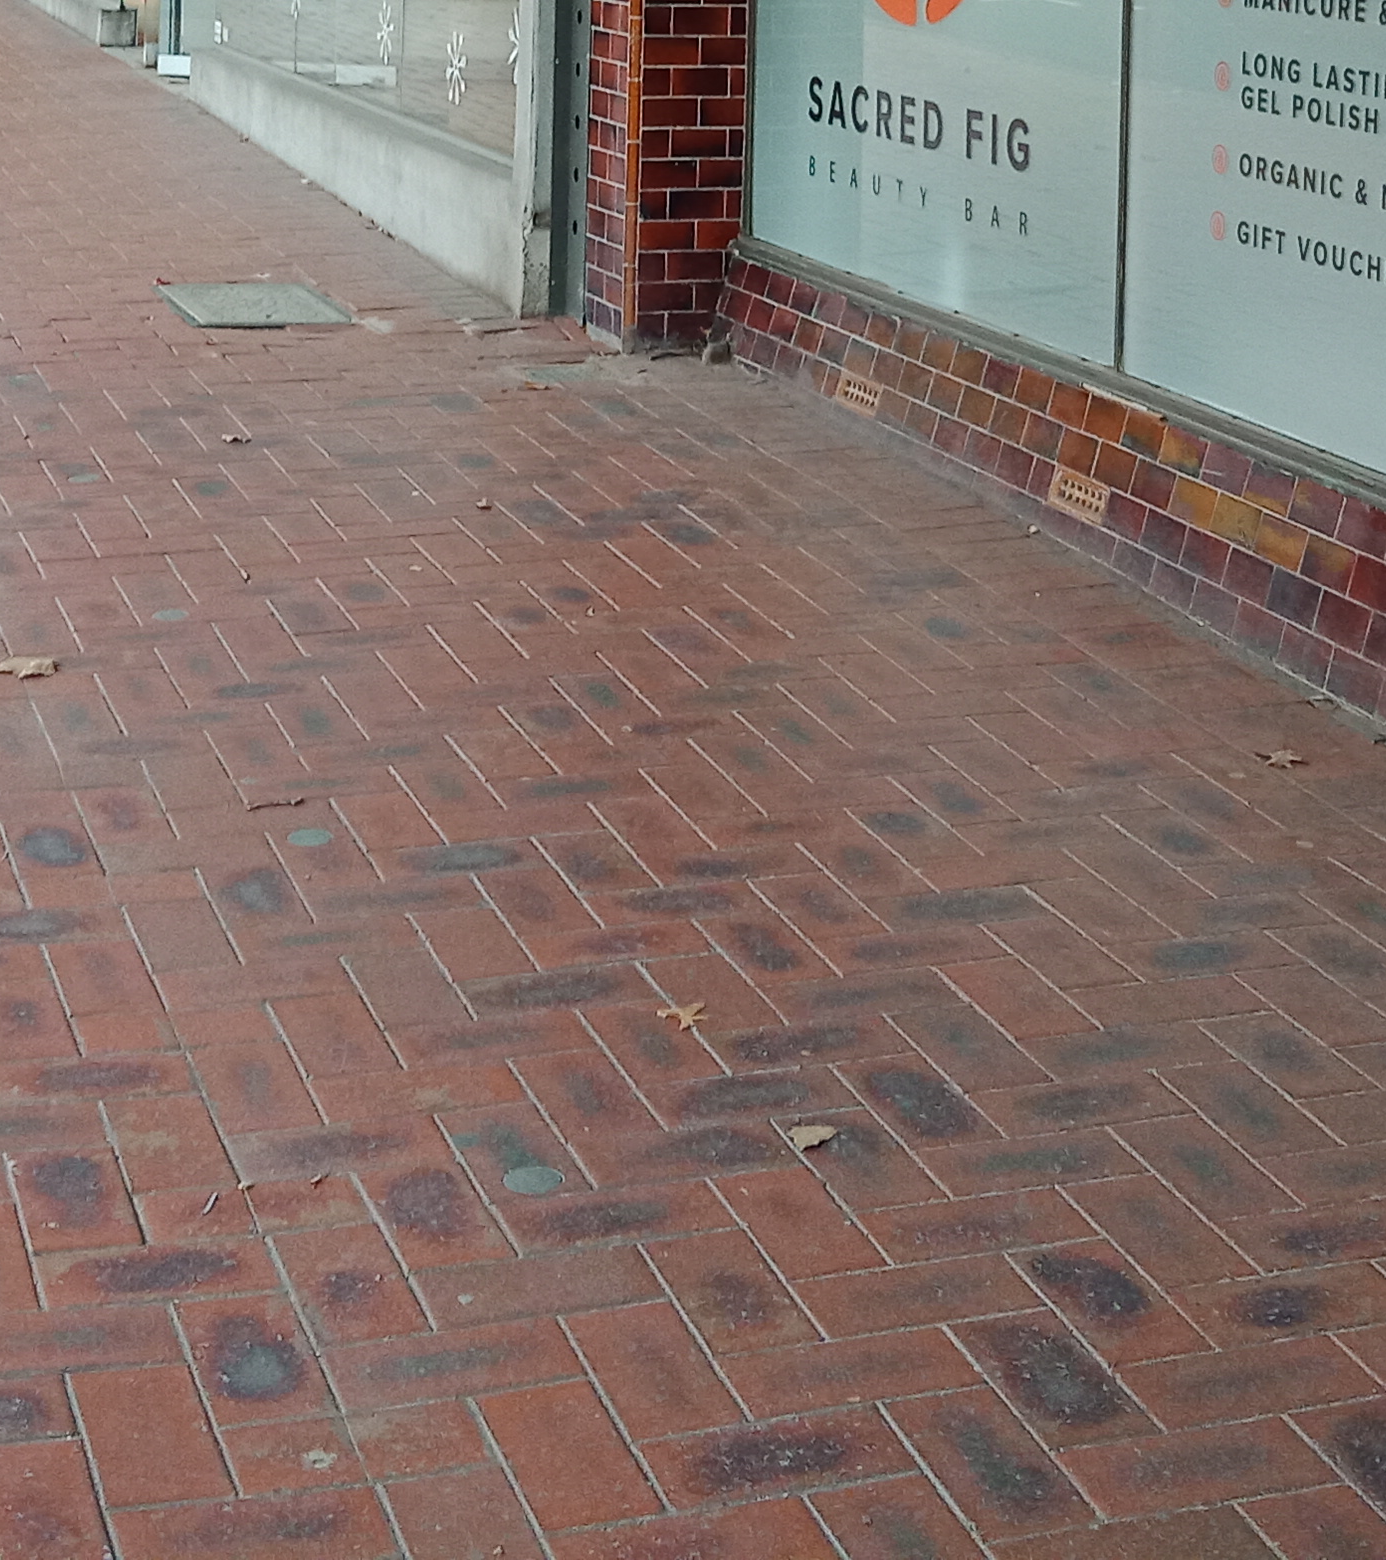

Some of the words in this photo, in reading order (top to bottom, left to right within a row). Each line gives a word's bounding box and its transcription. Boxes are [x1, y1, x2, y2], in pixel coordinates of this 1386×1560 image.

[1241, 51, 1301, 83] LONG
[808, 76, 943, 150] SACRED
[966, 108, 1030, 172] FIG
[1241, 86, 1281, 116] GEL
[1292, 95, 1380, 135] POLISH
[809, 155, 928, 208] BEAUTY
[964, 197, 1029, 236] BAR
[1239, 152, 1343, 199] ORGANIC
[1355, 178, 1368, 206] &
[1237, 220, 1286, 254] GIFT
